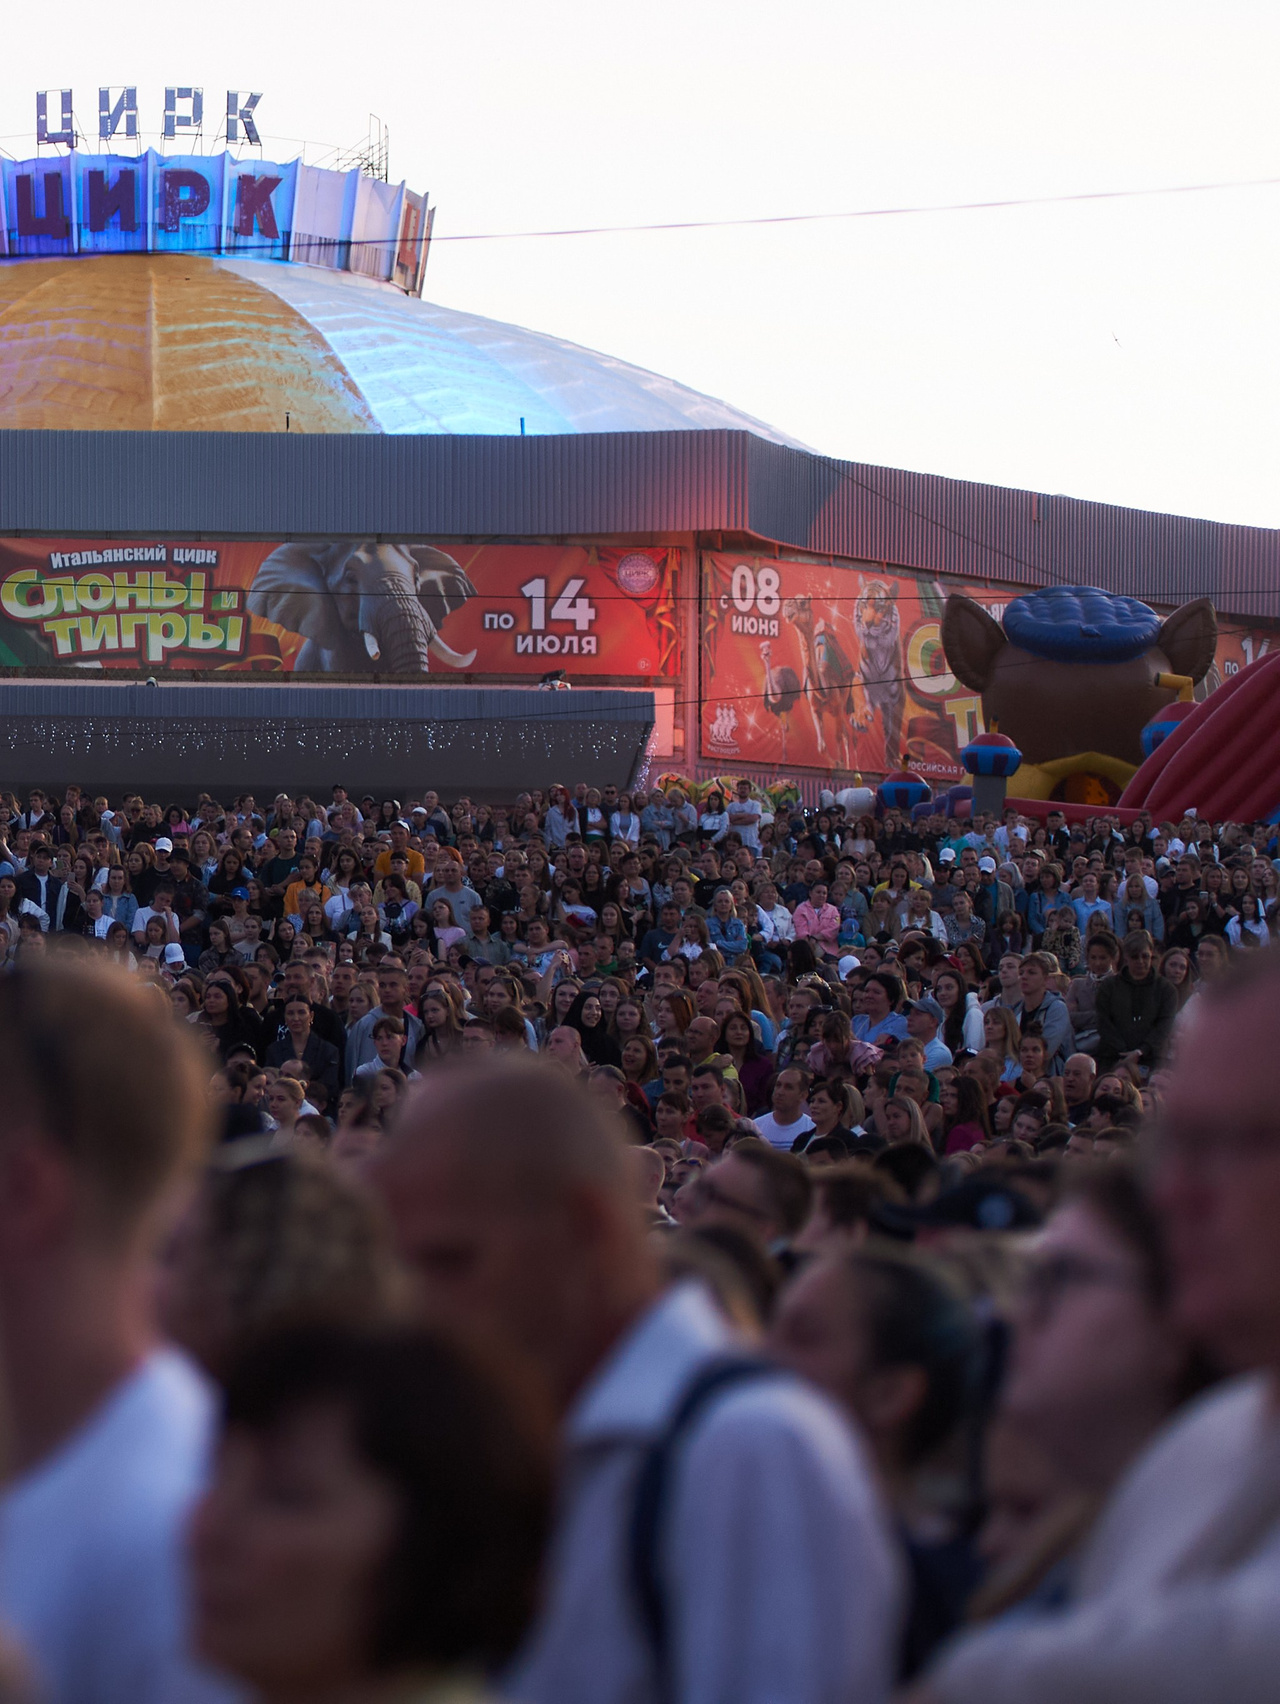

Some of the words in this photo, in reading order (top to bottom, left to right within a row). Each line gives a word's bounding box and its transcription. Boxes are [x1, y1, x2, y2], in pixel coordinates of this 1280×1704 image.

[36, 86, 263, 148] ЦИРК
[15, 169, 283, 239] ЦИРК
[50, 544, 166, 569] Итальянский
[173, 547, 217, 564] цирк
[521, 578, 595, 630] 14
[732, 565, 780, 616] 08
